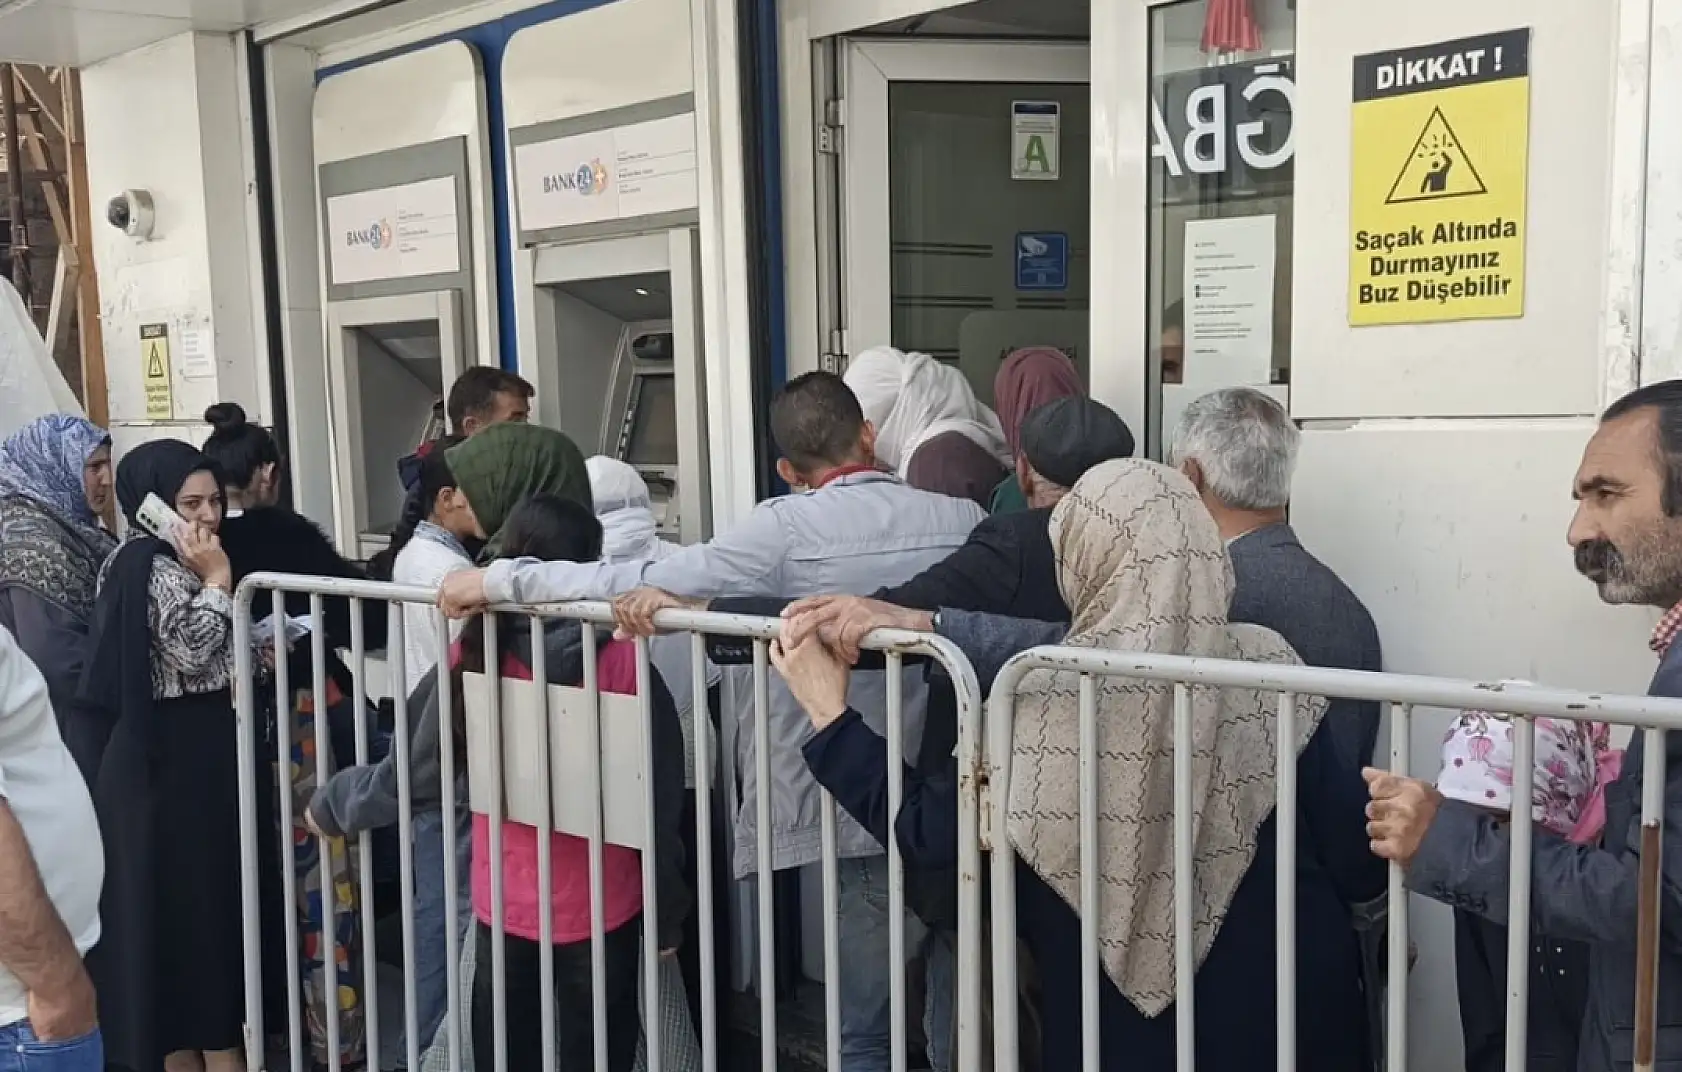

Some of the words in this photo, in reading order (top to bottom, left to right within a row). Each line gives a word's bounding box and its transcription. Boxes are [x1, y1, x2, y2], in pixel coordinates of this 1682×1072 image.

[1376, 48, 1486, 90] DİKKAT
[1493, 46, 1503, 72] !
[1023, 135, 1050, 173] A
[1355, 224, 1424, 253] Saçak
[1431, 217, 1517, 245] Altında
[1370, 251, 1500, 276] Durmayınız
[1359, 283, 1400, 304] Buz
[1406, 274, 1512, 304] Düşebilir
